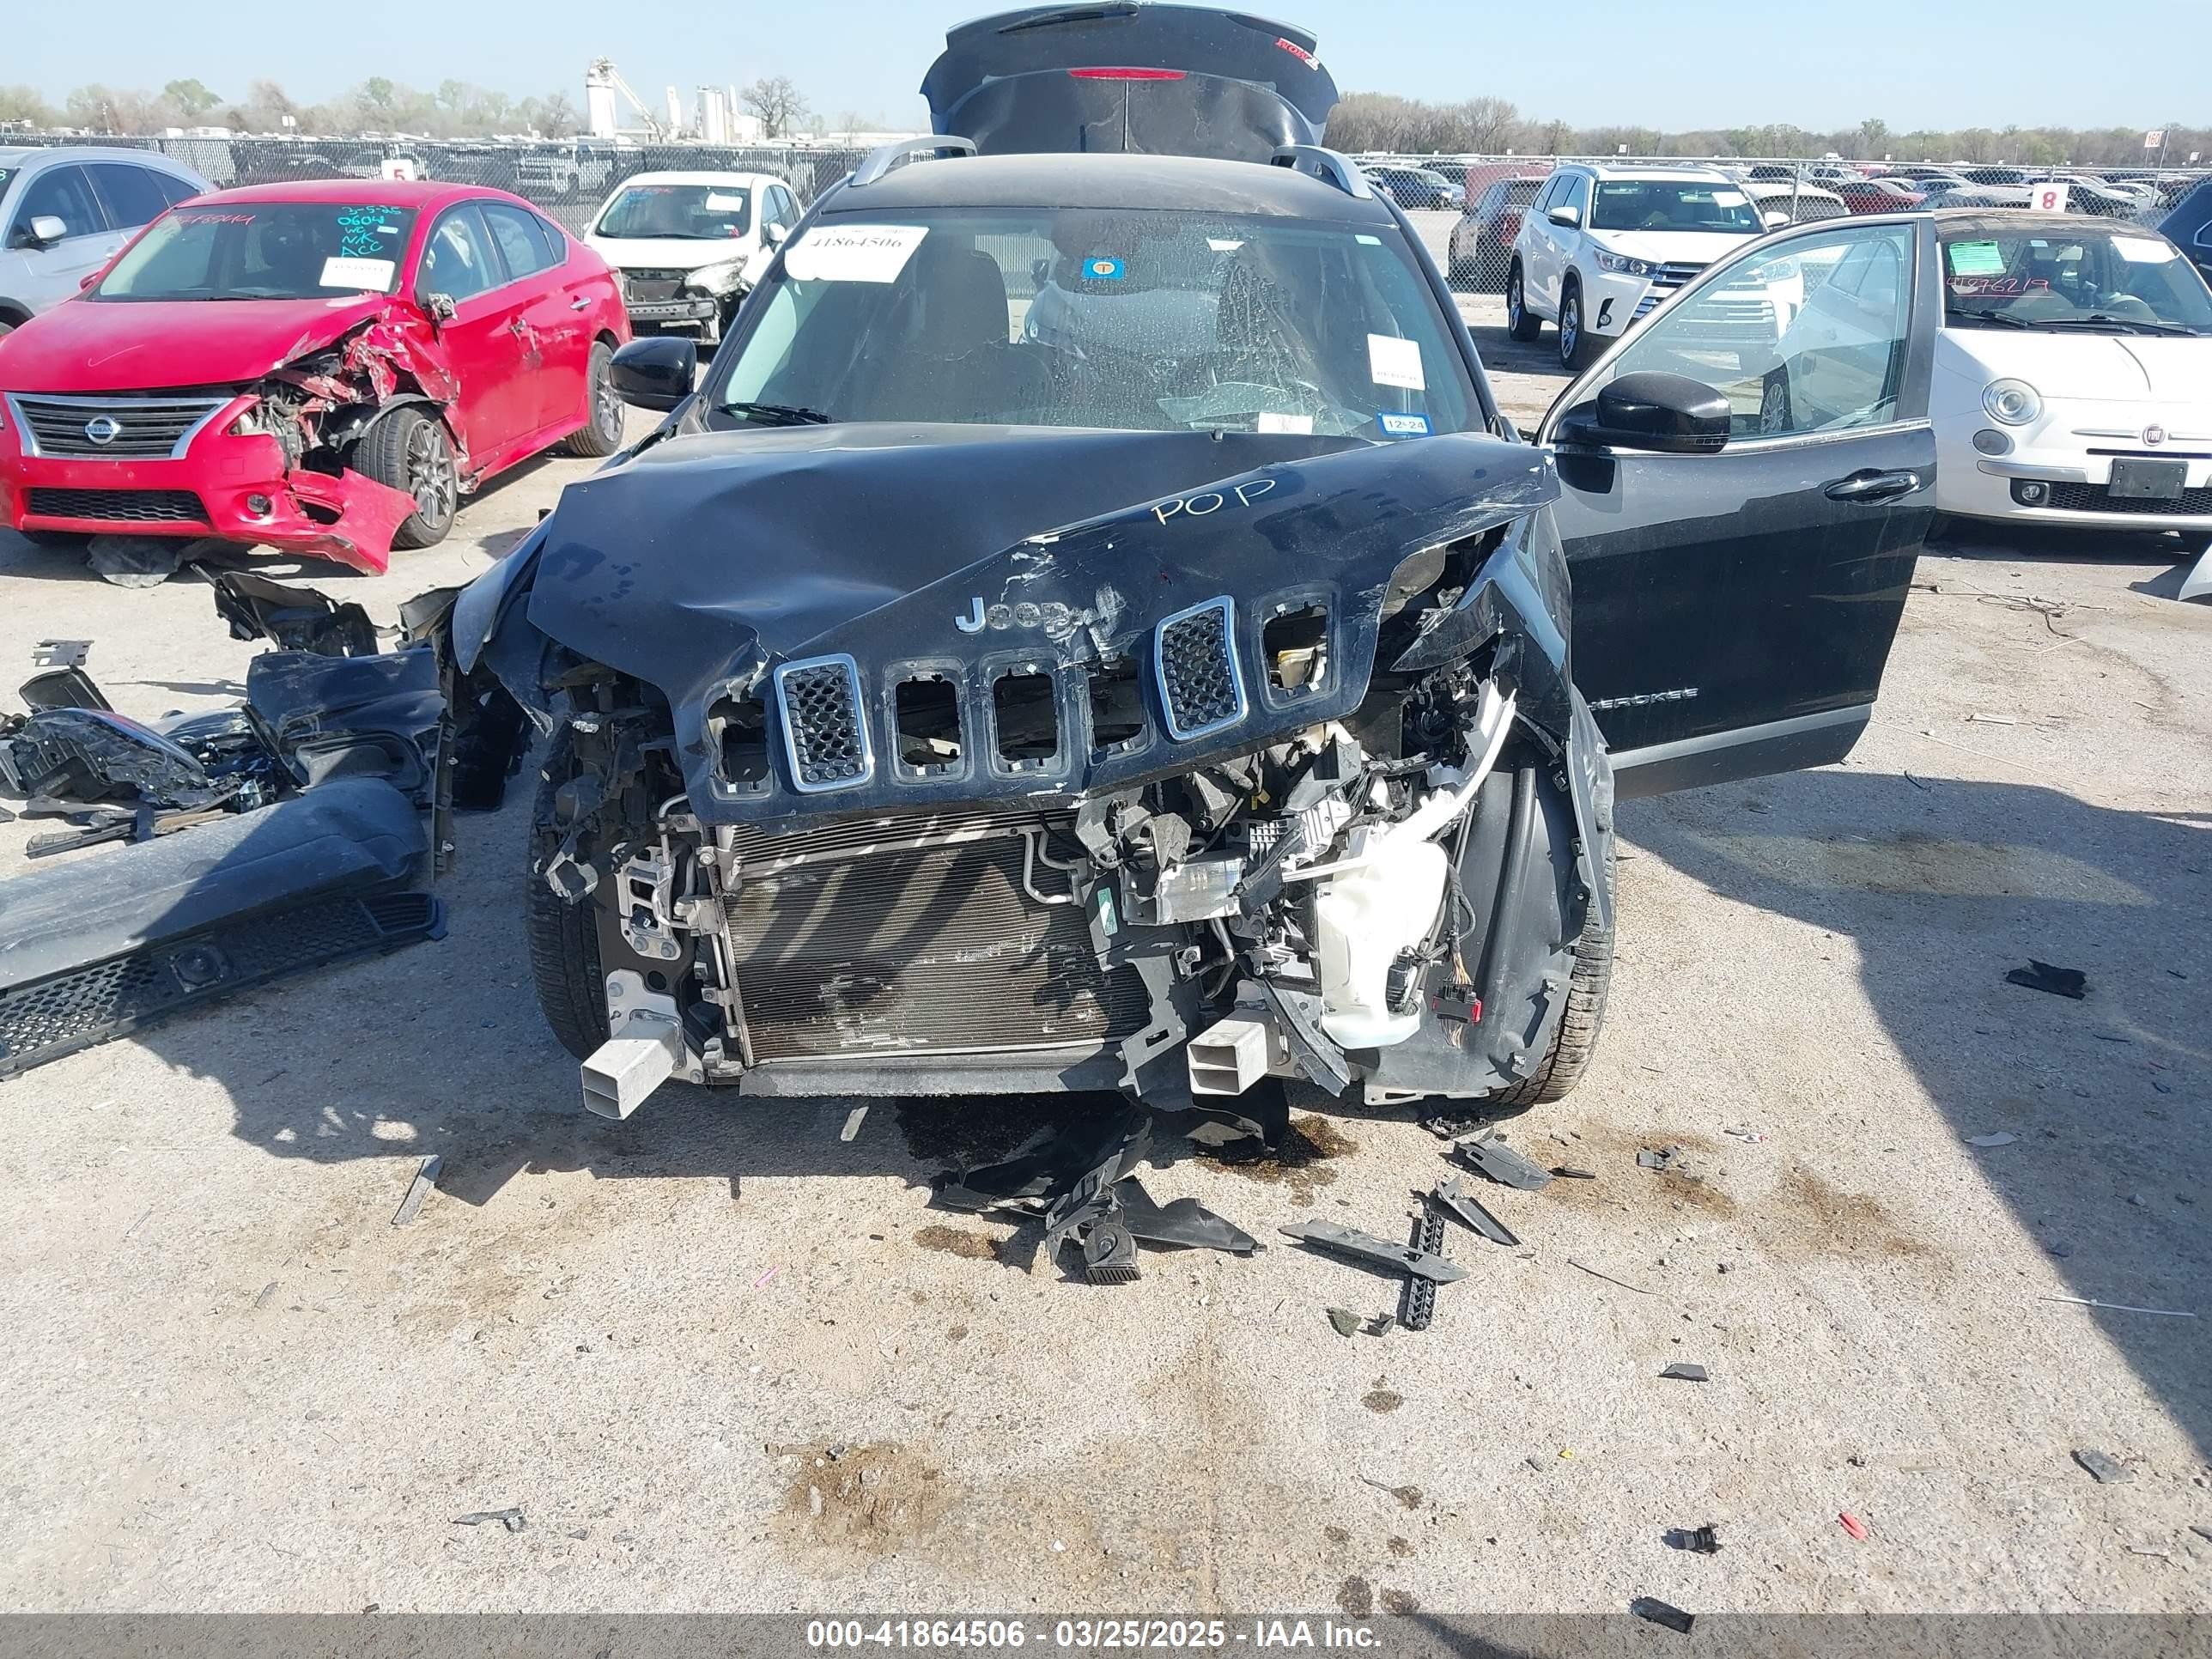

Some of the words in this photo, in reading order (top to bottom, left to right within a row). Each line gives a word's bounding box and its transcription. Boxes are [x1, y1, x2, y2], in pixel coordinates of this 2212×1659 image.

[2148, 133, 2160, 145] 160
[2043, 191, 2057, 210] 8
[341, 241, 384, 258] ACC
